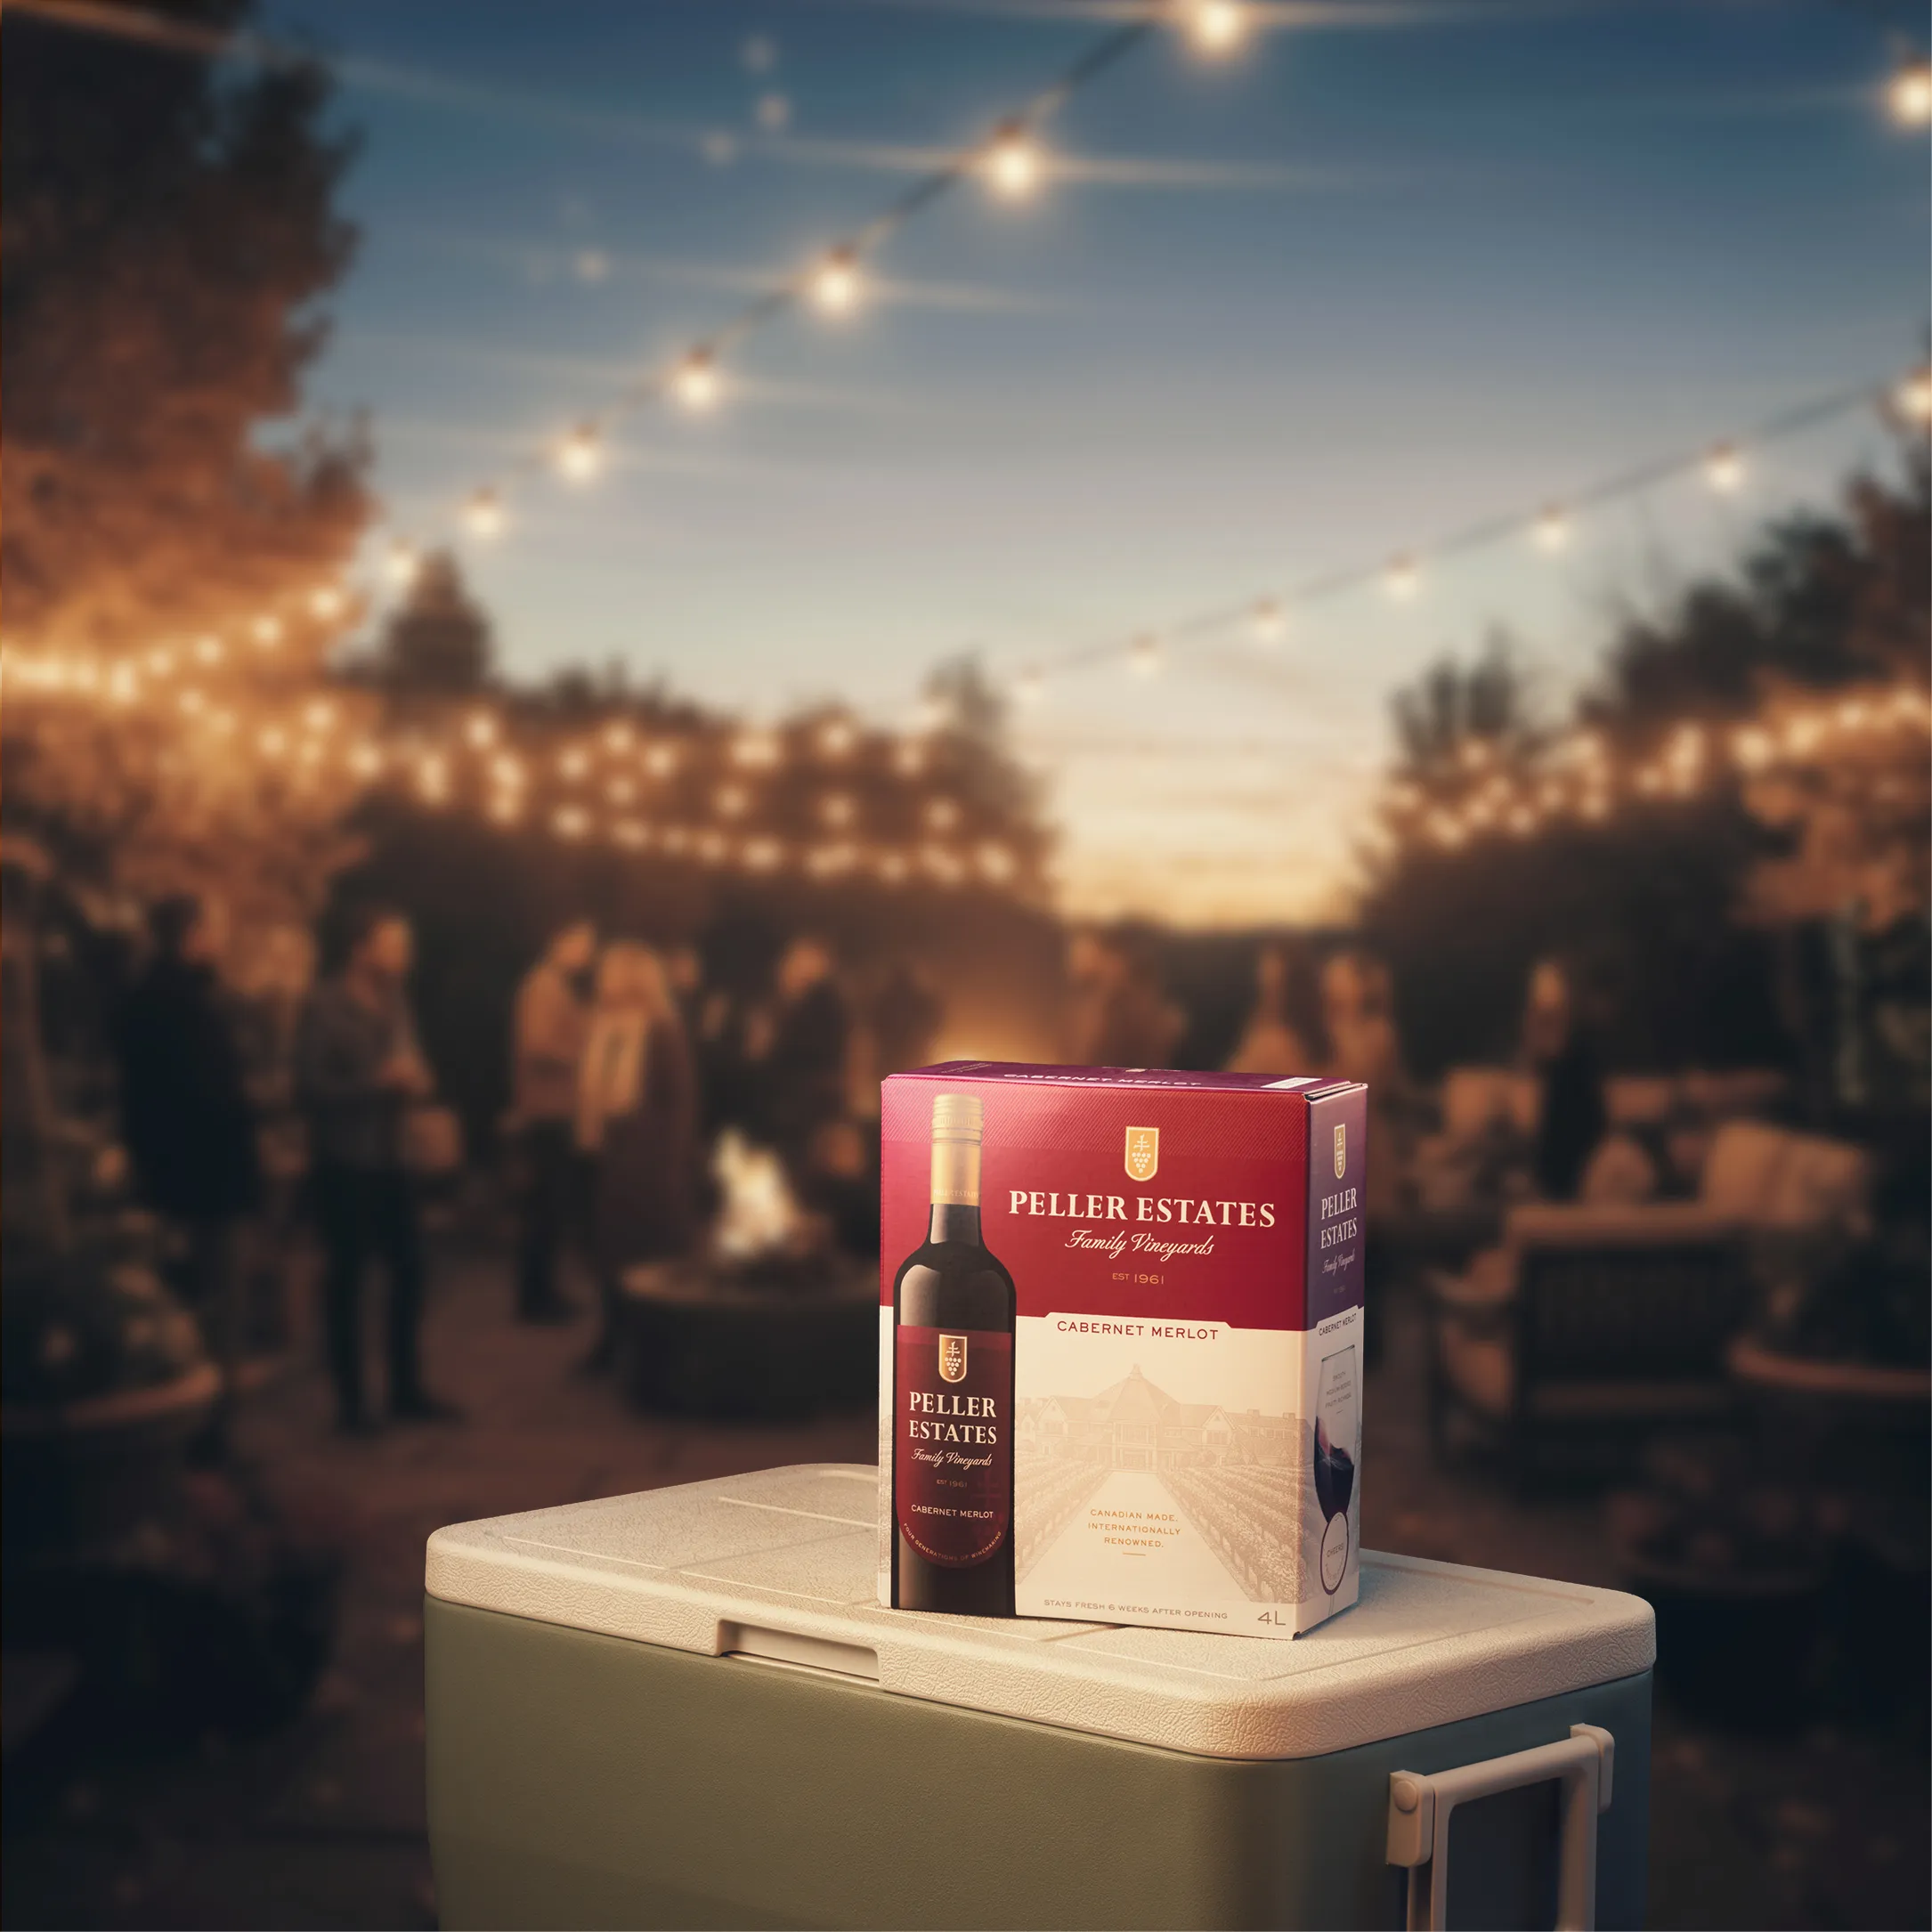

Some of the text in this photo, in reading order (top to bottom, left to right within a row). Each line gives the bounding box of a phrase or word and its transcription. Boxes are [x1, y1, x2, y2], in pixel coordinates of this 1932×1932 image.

[1009, 1190, 1275, 1228] PELLER ESTATES
[1321, 1187, 1357, 1221] PELLER
[1320, 1217, 1357, 1249] ESTATES
[1065, 1230, 1214, 1262] Family Vineyards
[1112, 1273, 1165, 1285] EST 1961
[1057, 1320, 1219, 1340] CABERNET MERLOT
[909, 1391, 997, 1417] PELLER
[909, 1419, 997, 1444] ESTATES
[912, 1448, 993, 1471] Family Vineyards
[949, 1480, 968, 1488] 1961
[911, 1504, 994, 1519] CABERNET MERLOT
[1090, 1509, 1179, 1522] CANADIAN MADE.
[1088, 1522, 1181, 1536] INTERNATIONALLY
[904, 1522, 915, 1540] FOUR
[914, 1539, 958, 1562] GENERATIONS
[970, 1530, 1002, 1559] WINEMAKING
[1104, 1537, 1165, 1548] RENOWNED.
[1043, 1599, 1073, 1608] STAYS
[1075, 1602, 1106, 1610] FRESH
[1117, 1604, 1150, 1613] WEEKS
[1152, 1607, 1181, 1617] AFTER
[1183, 1610, 1229, 1619] OPENING
[1256, 1610, 1287, 1627] 4L
